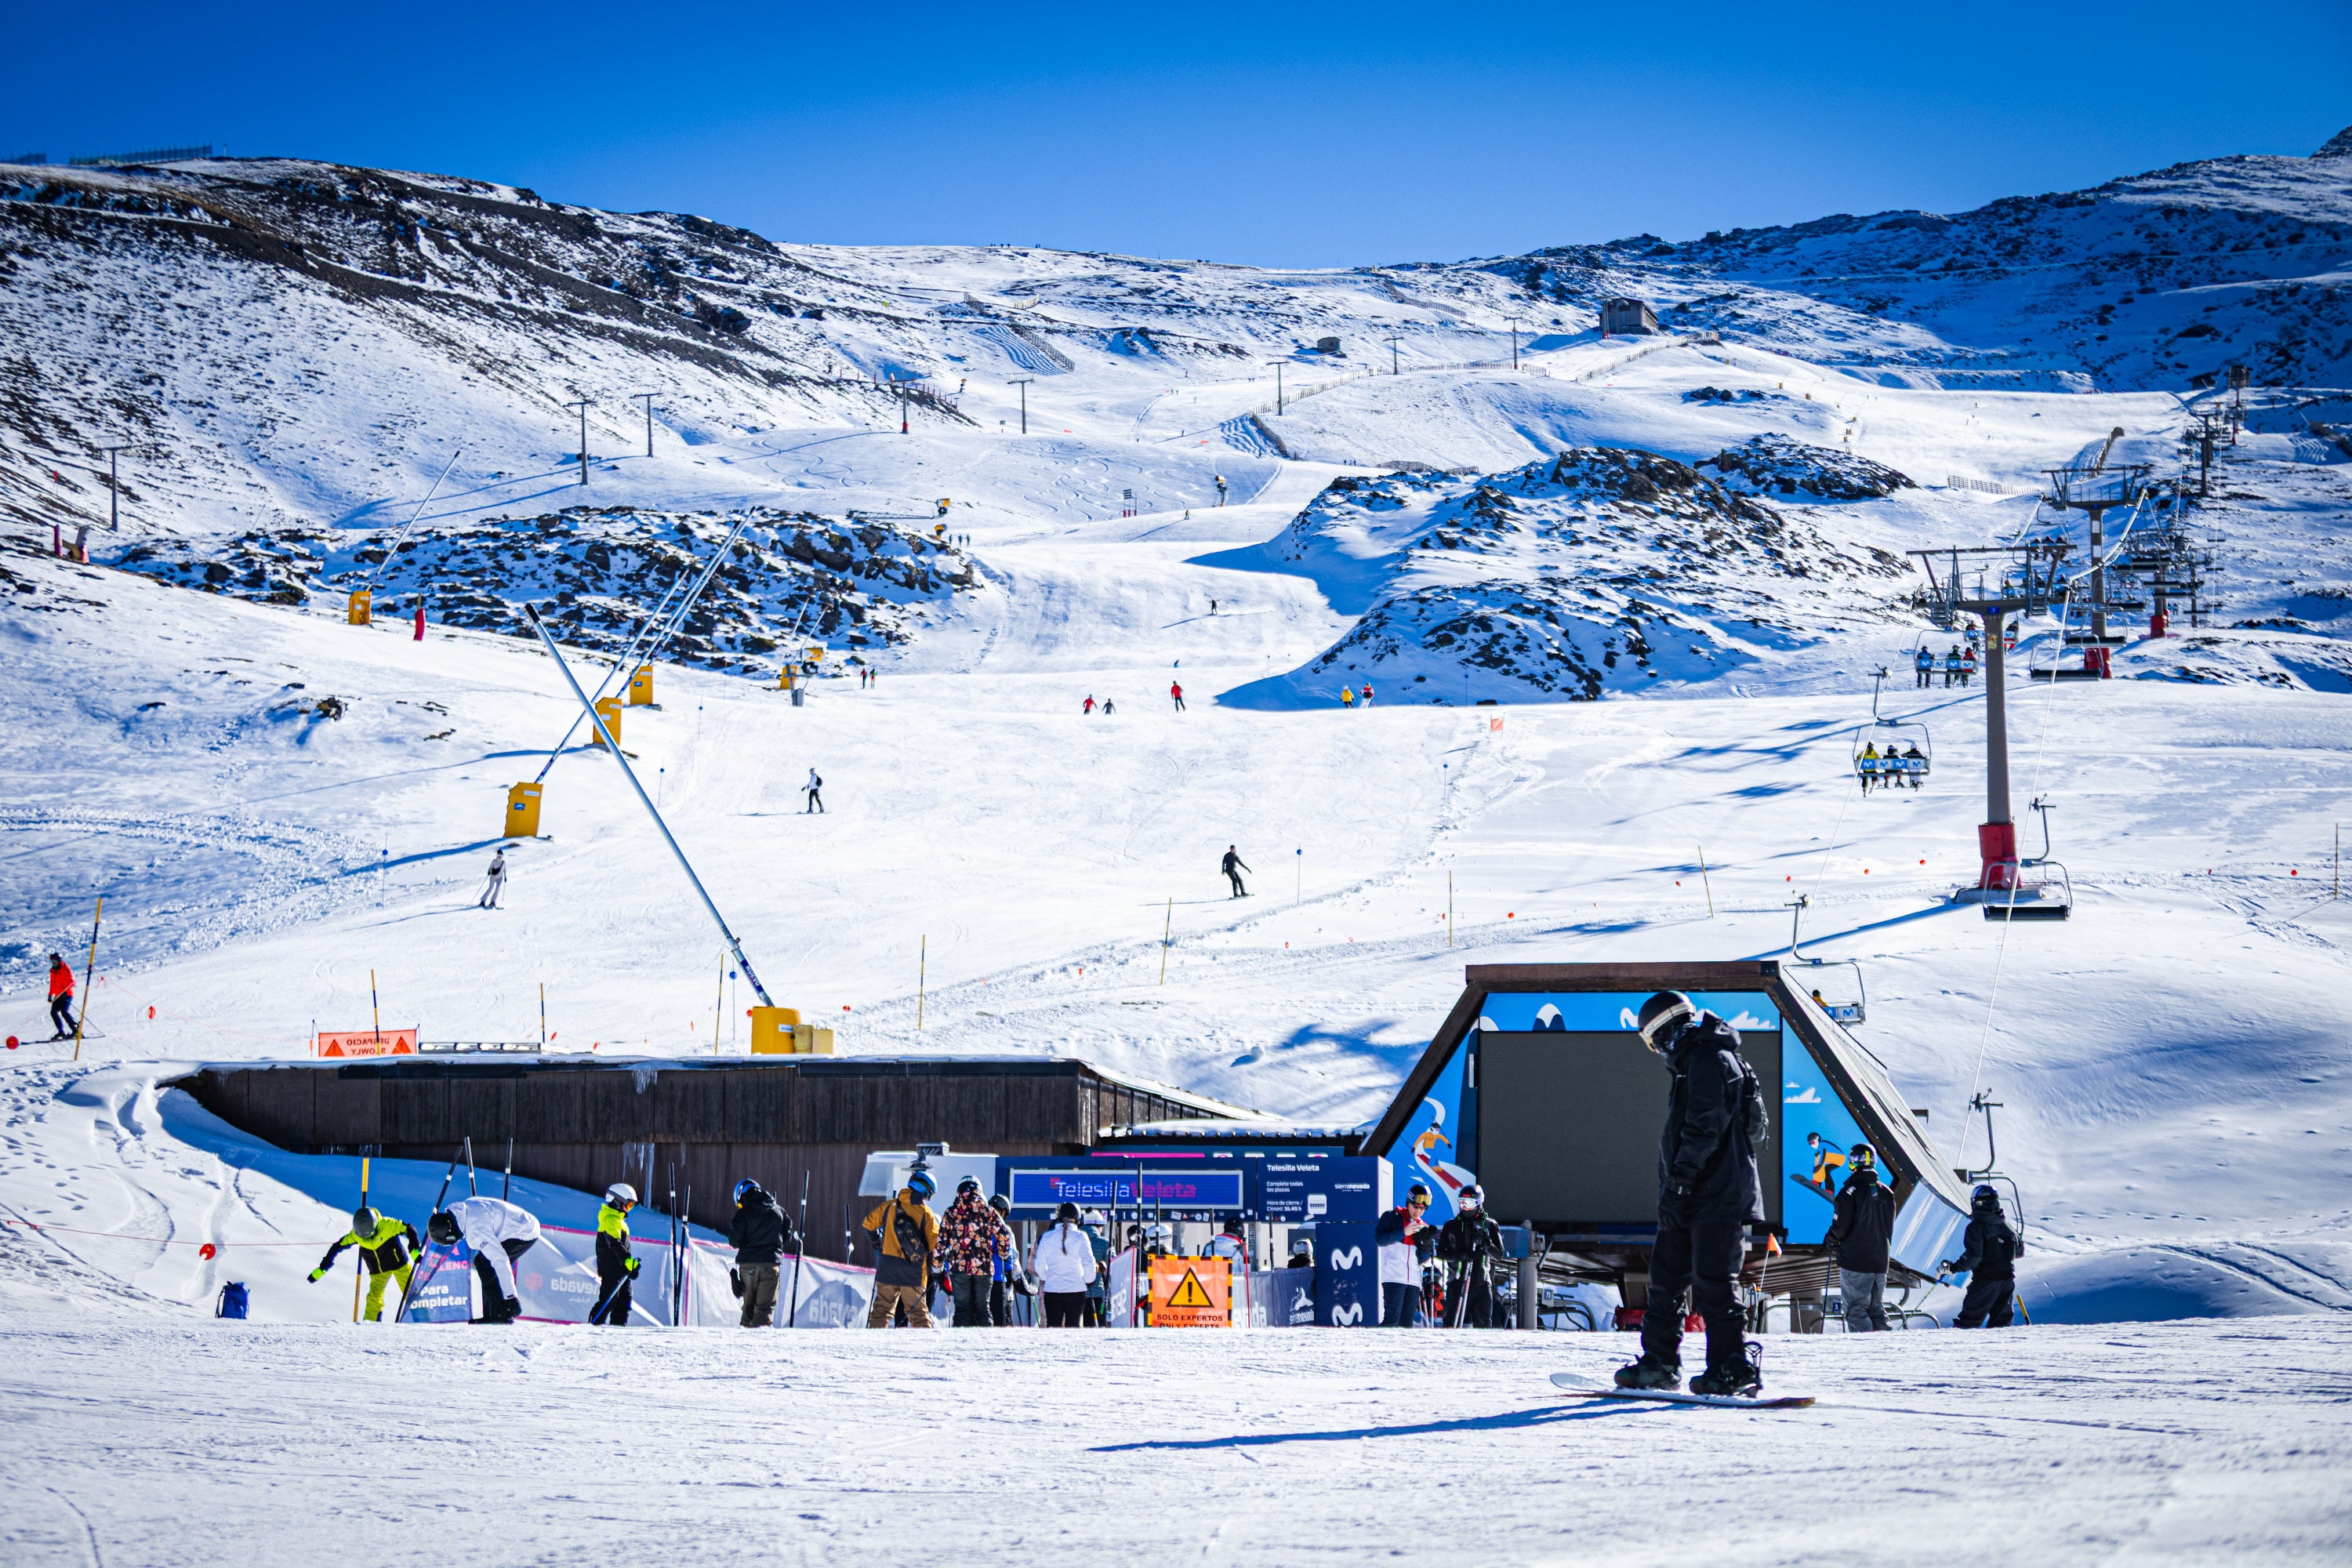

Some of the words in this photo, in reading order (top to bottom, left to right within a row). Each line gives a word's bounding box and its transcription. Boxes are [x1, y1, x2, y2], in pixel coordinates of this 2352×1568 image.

[1054, 1180, 1130, 1197] Telesila
[1130, 1181, 1196, 1198] Veleta
[409, 1296, 468, 1310] ompletar
